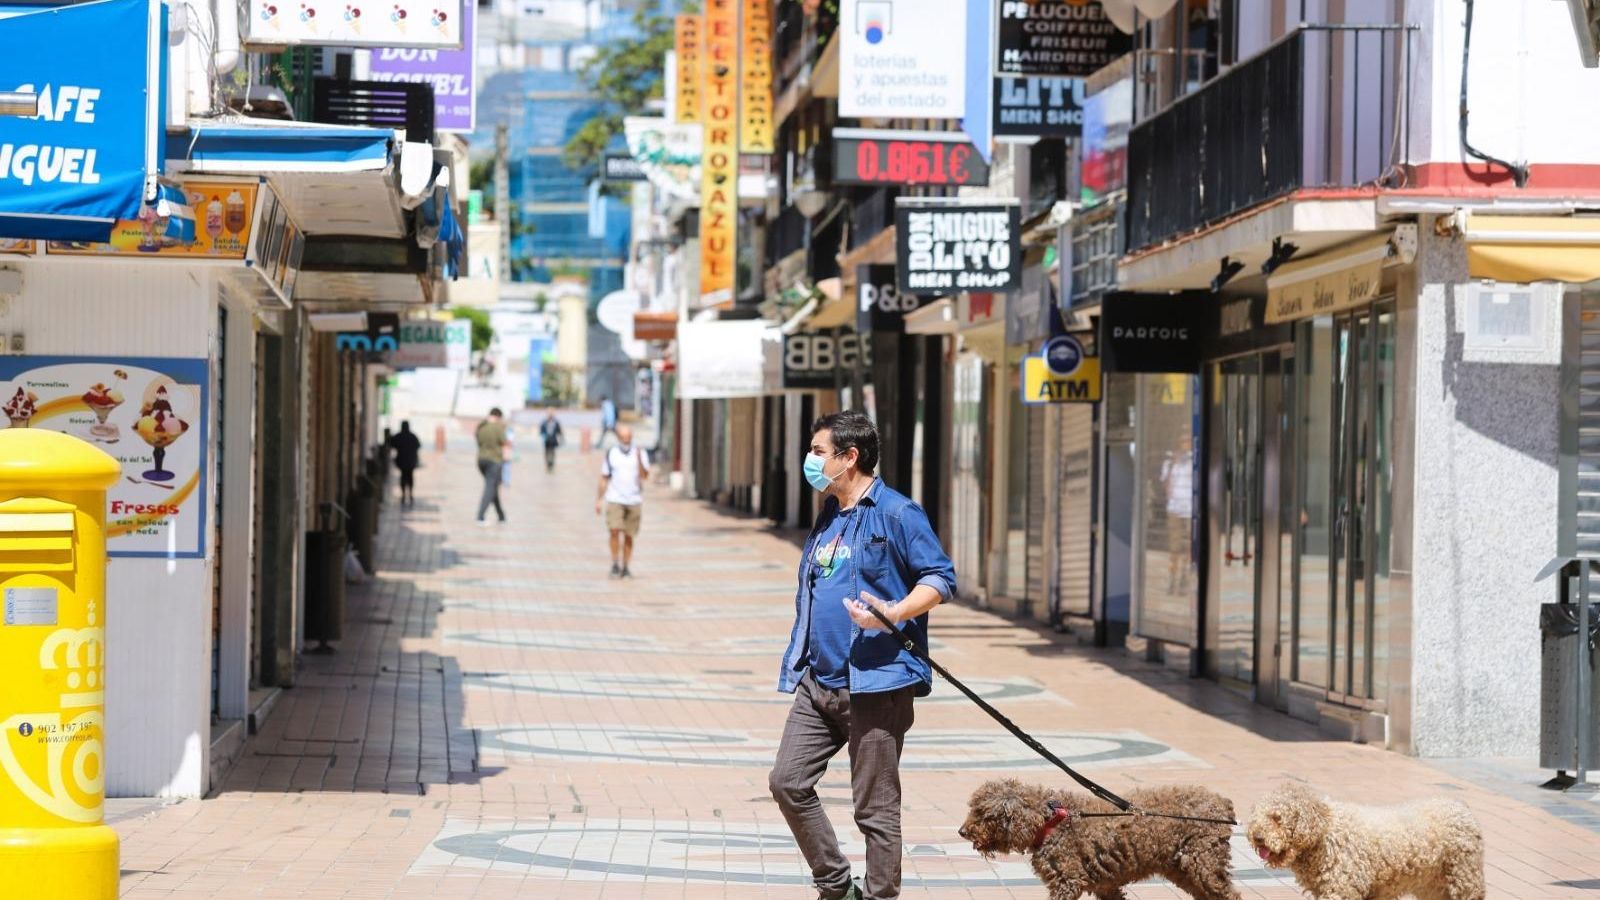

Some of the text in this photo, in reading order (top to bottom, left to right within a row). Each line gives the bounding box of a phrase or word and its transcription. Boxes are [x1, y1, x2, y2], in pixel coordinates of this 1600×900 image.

[1023, 20, 1116, 34] COIFFEUR
[713, 20, 729, 60] EL
[1030, 35, 1107, 49] FRISEUR
[853, 53, 917, 69] loterias
[870, 72, 949, 88] apuestas
[856, 92, 947, 108] del estado
[710, 80, 730, 171] TORO
[1000, 109, 1084, 125] MEN SHO
[0, 143, 101, 186] IGUEL
[708, 189, 727, 277] AZUL
[908, 211, 1010, 272] DON MIGUE
[933, 240, 1011, 271] LITO
[908, 270, 1011, 288] MEN SHOP
[399, 325, 466, 344] EGALOS
[1113, 326, 1188, 340] PARFOIS
[1039, 380, 1089, 398] ATM
[111, 500, 180, 515] Fresas
[37, 724, 57, 733] 902
[61, 722, 77, 732] 197
